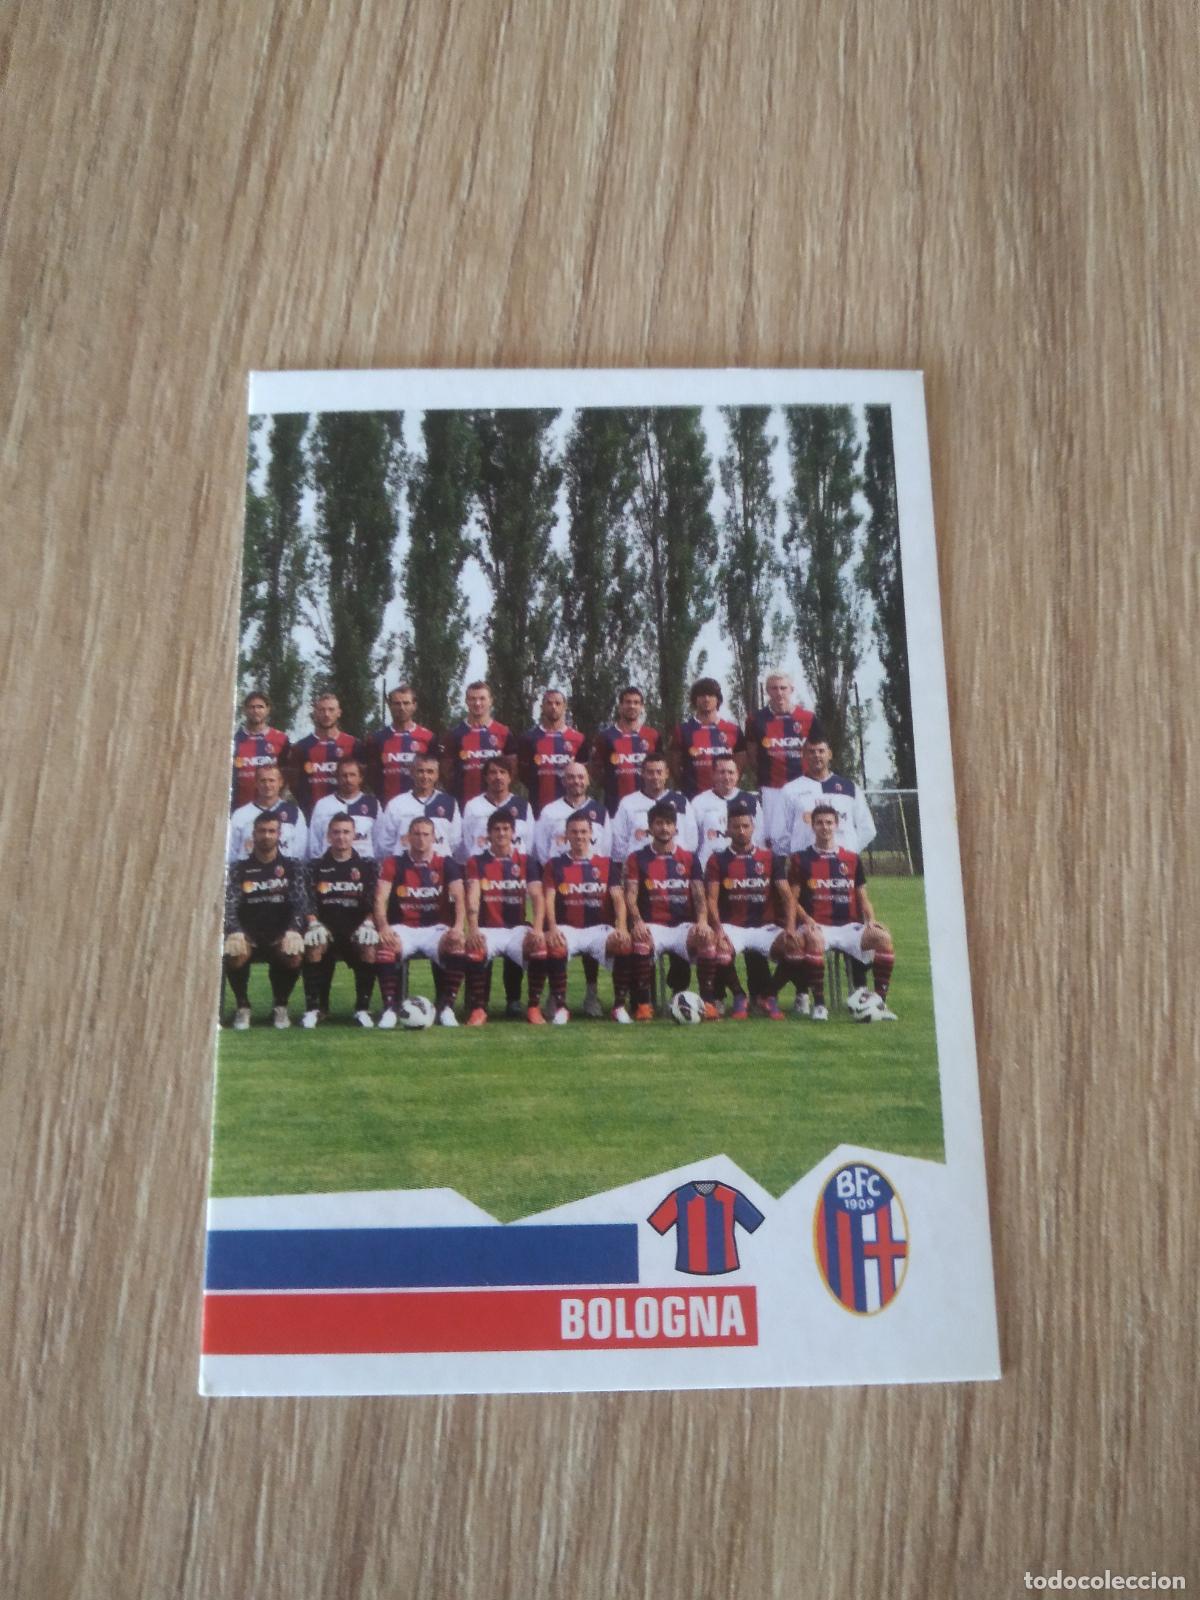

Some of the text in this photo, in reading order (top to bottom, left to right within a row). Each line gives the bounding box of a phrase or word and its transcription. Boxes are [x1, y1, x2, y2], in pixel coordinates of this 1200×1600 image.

[836, 1167, 881, 1198] BFC
[844, 1198, 875, 1211] 1909
[560, 1295, 746, 1340] BOLOGNA
